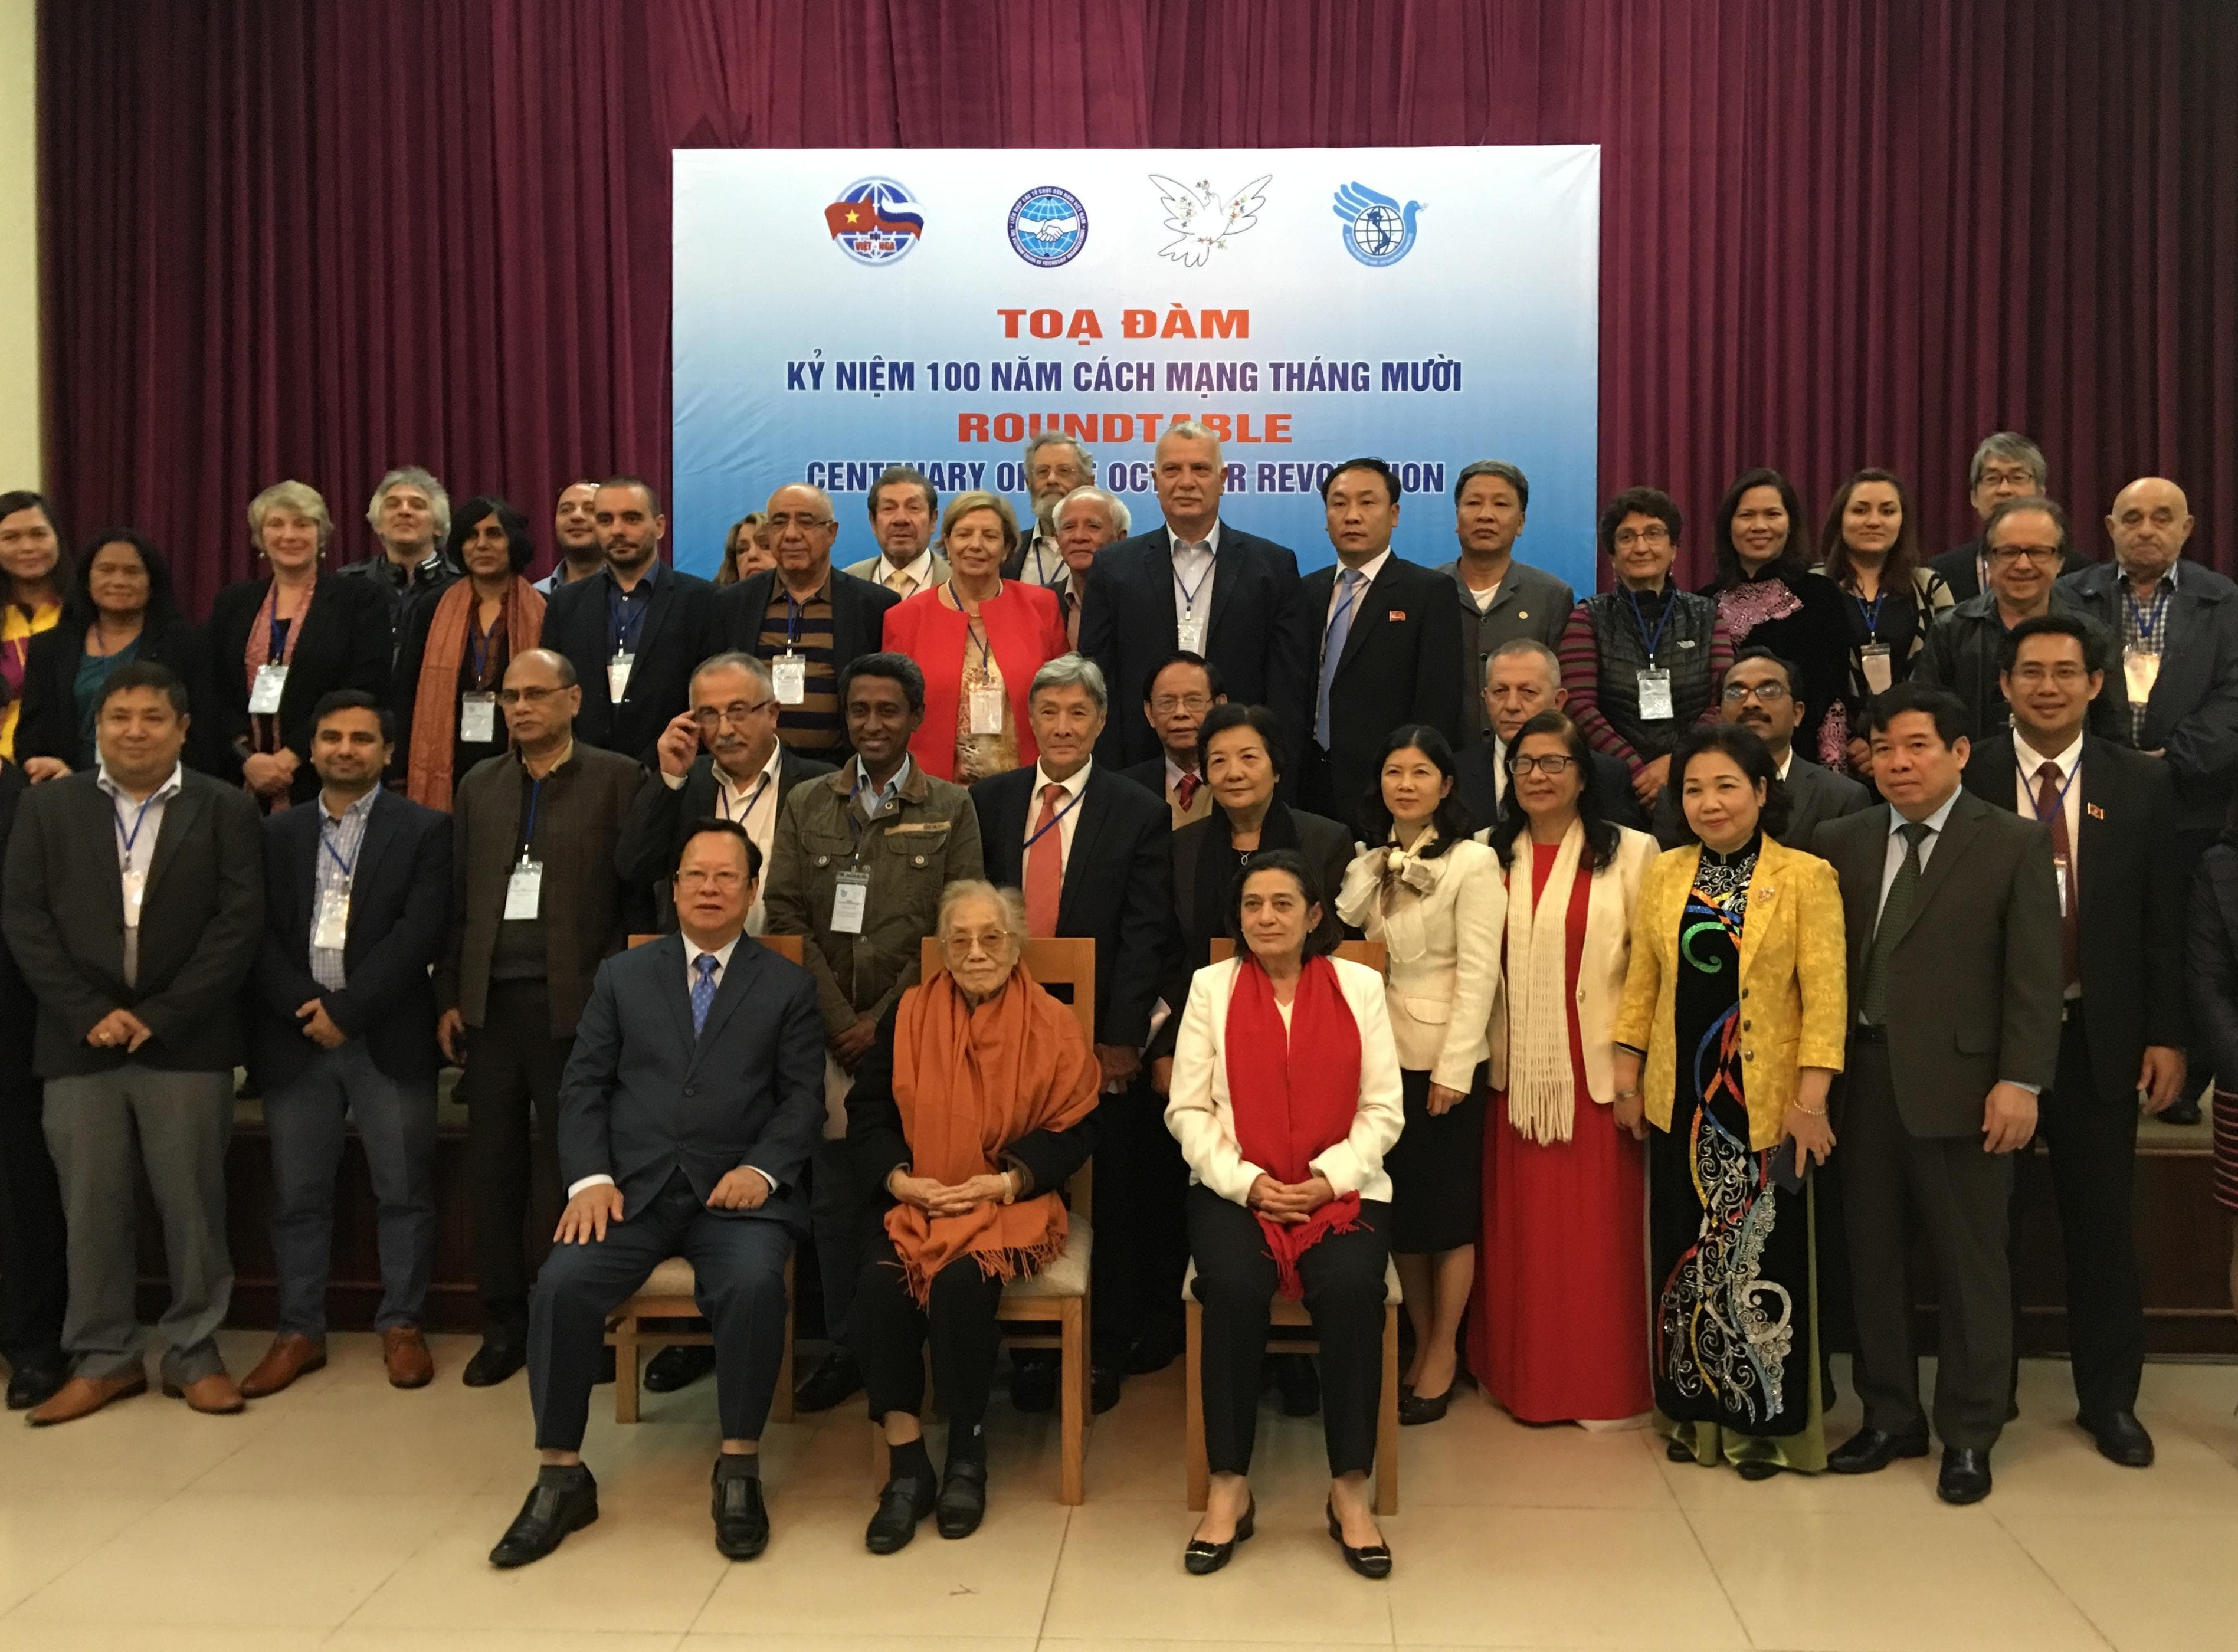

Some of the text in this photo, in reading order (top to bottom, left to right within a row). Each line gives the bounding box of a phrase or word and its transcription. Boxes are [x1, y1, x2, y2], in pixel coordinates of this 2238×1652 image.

[997, 303, 1249, 345] TOẠ ĐÀM
[787, 349, 1462, 398] KỶ NIỆM 100 NĂM CÁCH MẠNG THÁNG MƯỜI
[807, 462, 985, 491] CENTARY
